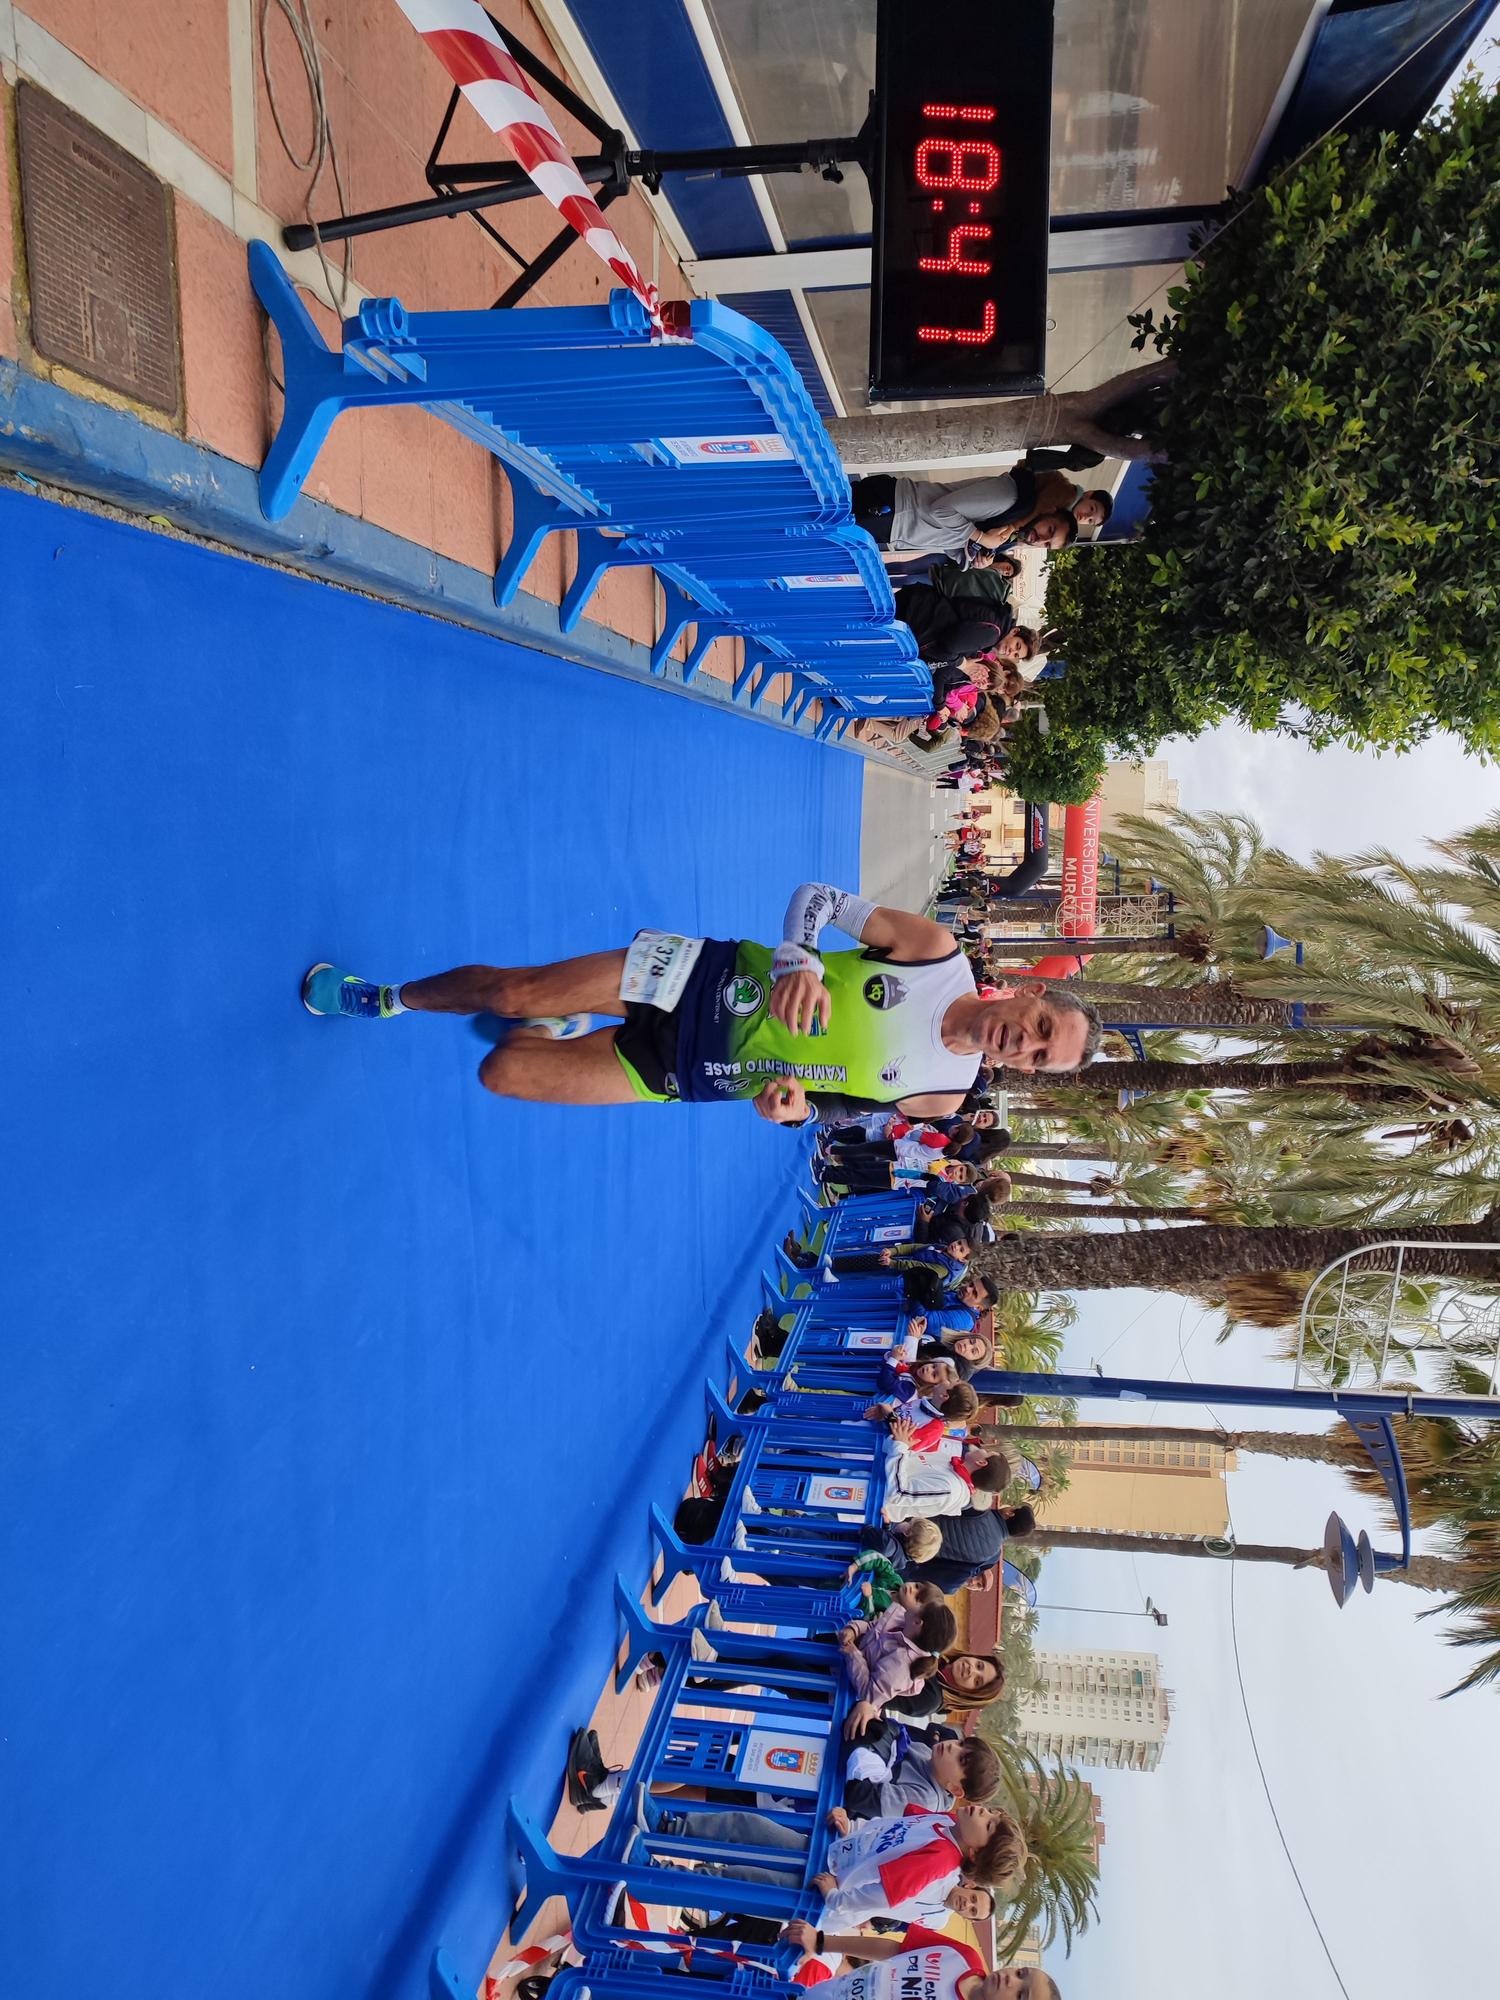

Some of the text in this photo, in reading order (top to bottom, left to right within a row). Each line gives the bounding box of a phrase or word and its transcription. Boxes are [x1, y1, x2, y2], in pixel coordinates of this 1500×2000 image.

[914, 104, 1001, 345] 18:47
[1079, 797, 1097, 923] NIVERSIDAD DE
[1063, 857, 1078, 921] MURCIA
[650, 946, 674, 978] 378
[703, 1059, 848, 1082] KAMPAMENTO BASE
[901, 1977, 922, 2000] Ni
